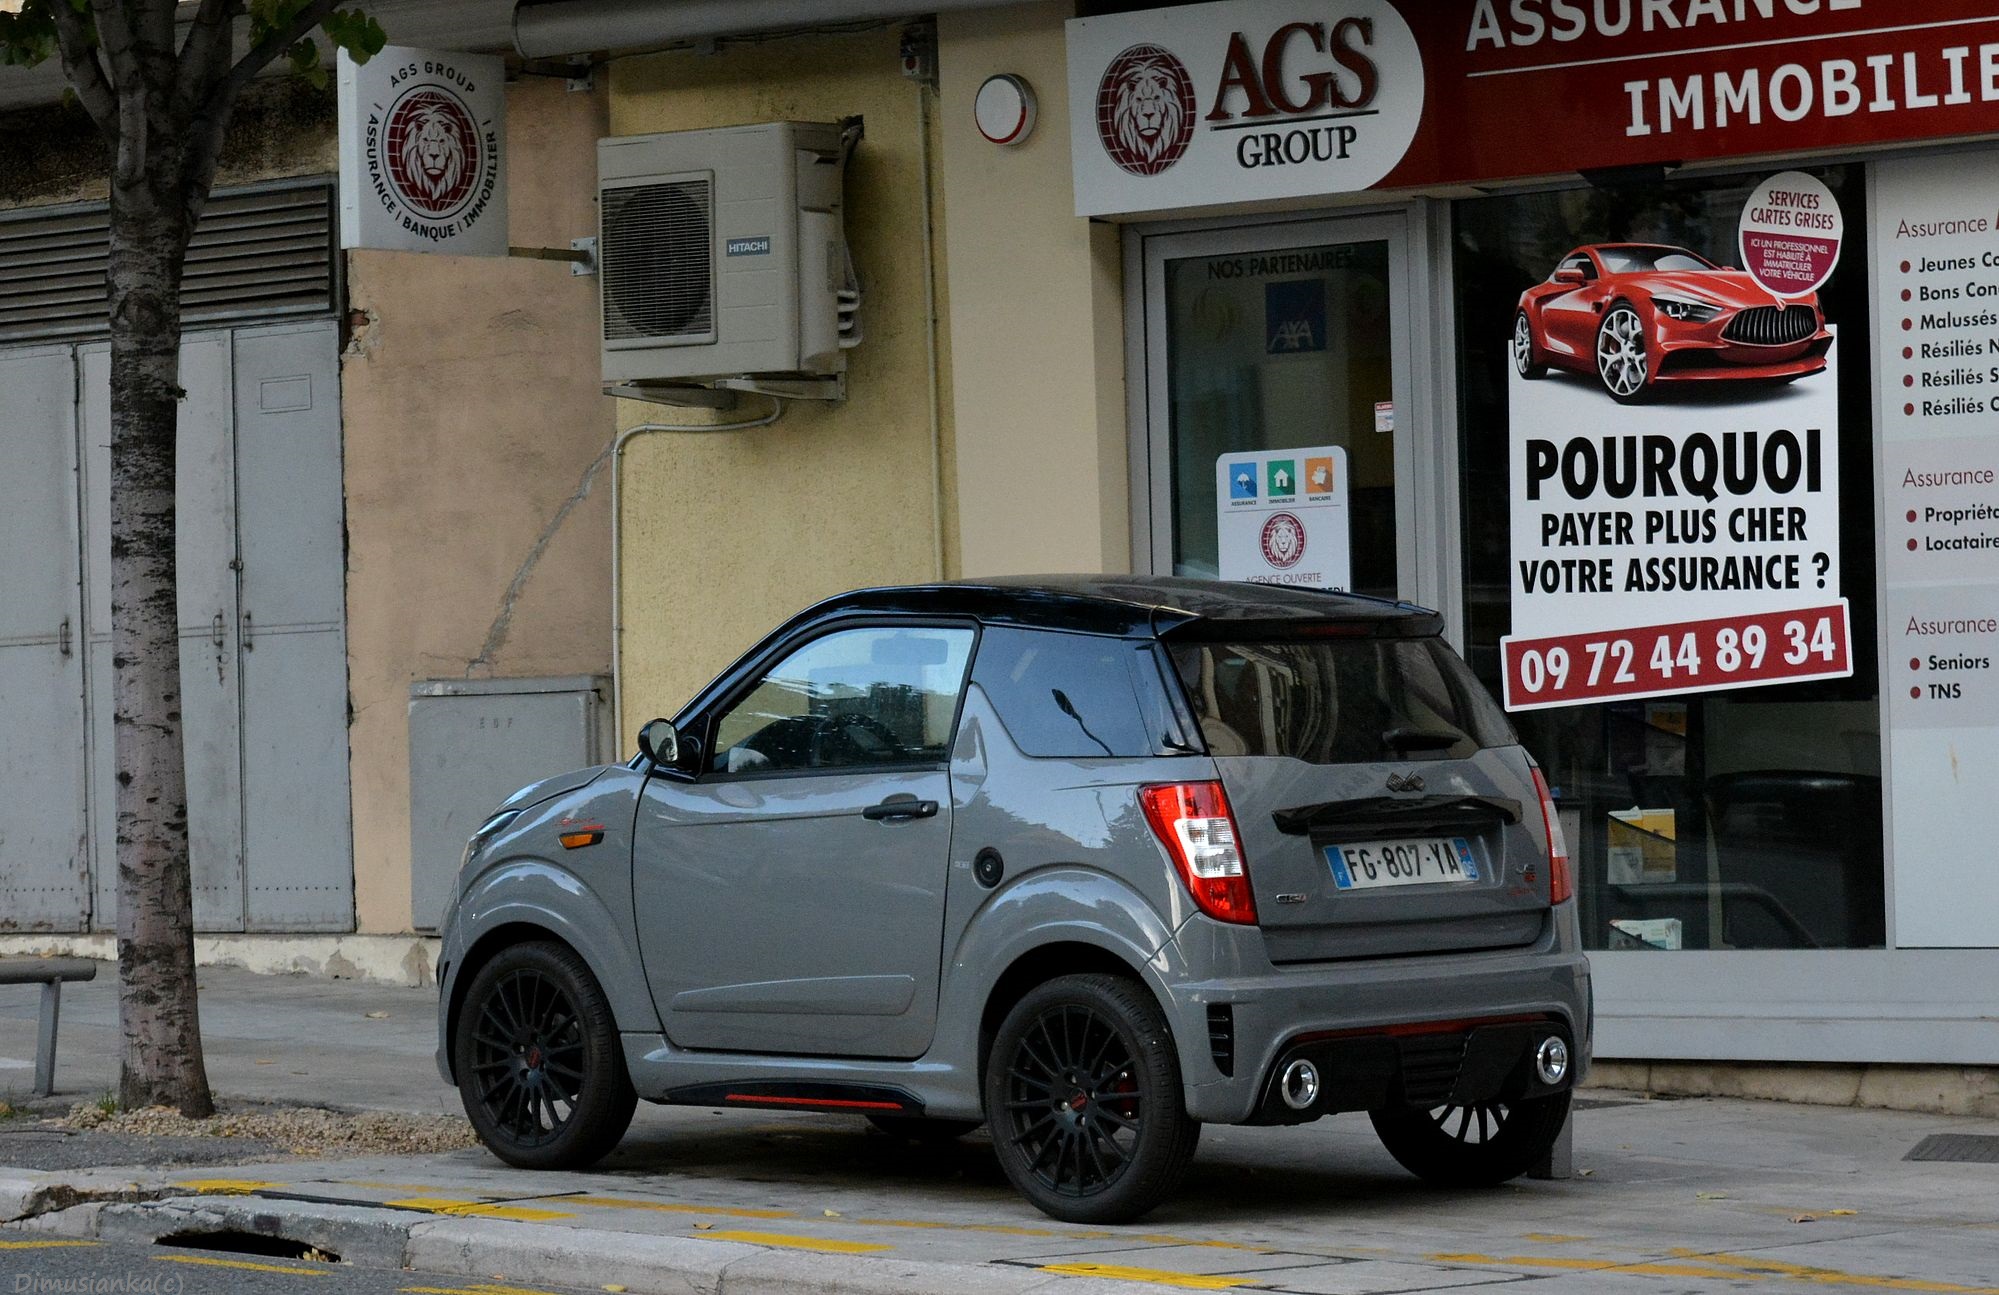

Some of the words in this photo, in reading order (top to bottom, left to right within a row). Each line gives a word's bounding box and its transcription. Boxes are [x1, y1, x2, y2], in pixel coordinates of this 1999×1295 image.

[1466, 0, 1861, 51] ASSUR
[390, 64, 417, 88] AGS
[424, 61, 475, 93] GROUP
[1205, 17, 1379, 121] AGS
[1624, 44, 1999, 137] IMMOBILIE
[1237, 125, 1357, 169] GROUP
[366, 114, 397, 214] ASSURANCE
[402, 217, 455, 242] BANQUE
[464, 131, 498, 228] IMMOBILIER
[1768, 190, 1820, 210] SERVICES
[1751, 208, 1791, 226] CARTES
[1795, 212, 1834, 230] GRISES
[1896, 217, 1987, 239] Assurance
[728, 241, 768, 253] HITACHI
[1751, 239, 1760, 247] ICI
[1761, 240, 1772, 248] UN
[1774, 241, 1829, 254] PROFESSIONNEL
[1764, 250, 1775, 258] EST
[1208, 259, 1243, 280] NOS
[1249, 251, 1355, 277] PARTENAIRES
[1759, 268, 1781, 278] VOTRE
[1783, 269, 1815, 281] VÉHICULE
[1764, 259, 1812, 271] IMMATRICULER
[1918, 257, 1976, 273] Jeunes
[1920, 286, 1960, 301] Bons
[1965, 281, 1999, 297] Con
[1920, 309, 1998, 330] Malussés
[1271, 320, 1314, 350] AXA
[1921, 339, 1983, 359] Résiliés
[1922, 368, 1984, 387] Résiliés
[1923, 397, 1984, 416] Résiliés
[1526, 429, 1821, 503] POURQUOI
[1902, 467, 1994, 488] Assurance
[1541, 511, 1634, 547] PAYER
[1645, 508, 1717, 544] PLUS
[1728, 506, 1807, 543] CHER
[1926, 532, 1999, 551] Locataire
[1246, 575, 1280, 584] AGENCE
[1283, 573, 1322, 584] OUVERTE
[1519, 558, 1613, 594] VOTRE
[1624, 553, 1800, 592] ASSURANCE
[1811, 552, 1830, 589] ?
[1905, 616, 1997, 636] Assurance
[1520, 647, 1570, 694] 09
[1584, 639, 1636, 687] 72
[1650, 632, 1701, 679] 44
[1715, 624, 1768, 673] 89
[1783, 617, 1836, 666] 34
[1928, 653, 1990, 671] Seniors
[1928, 683, 1961, 699] TNS
[1344, 842, 1461, 882] FG-807-YA
